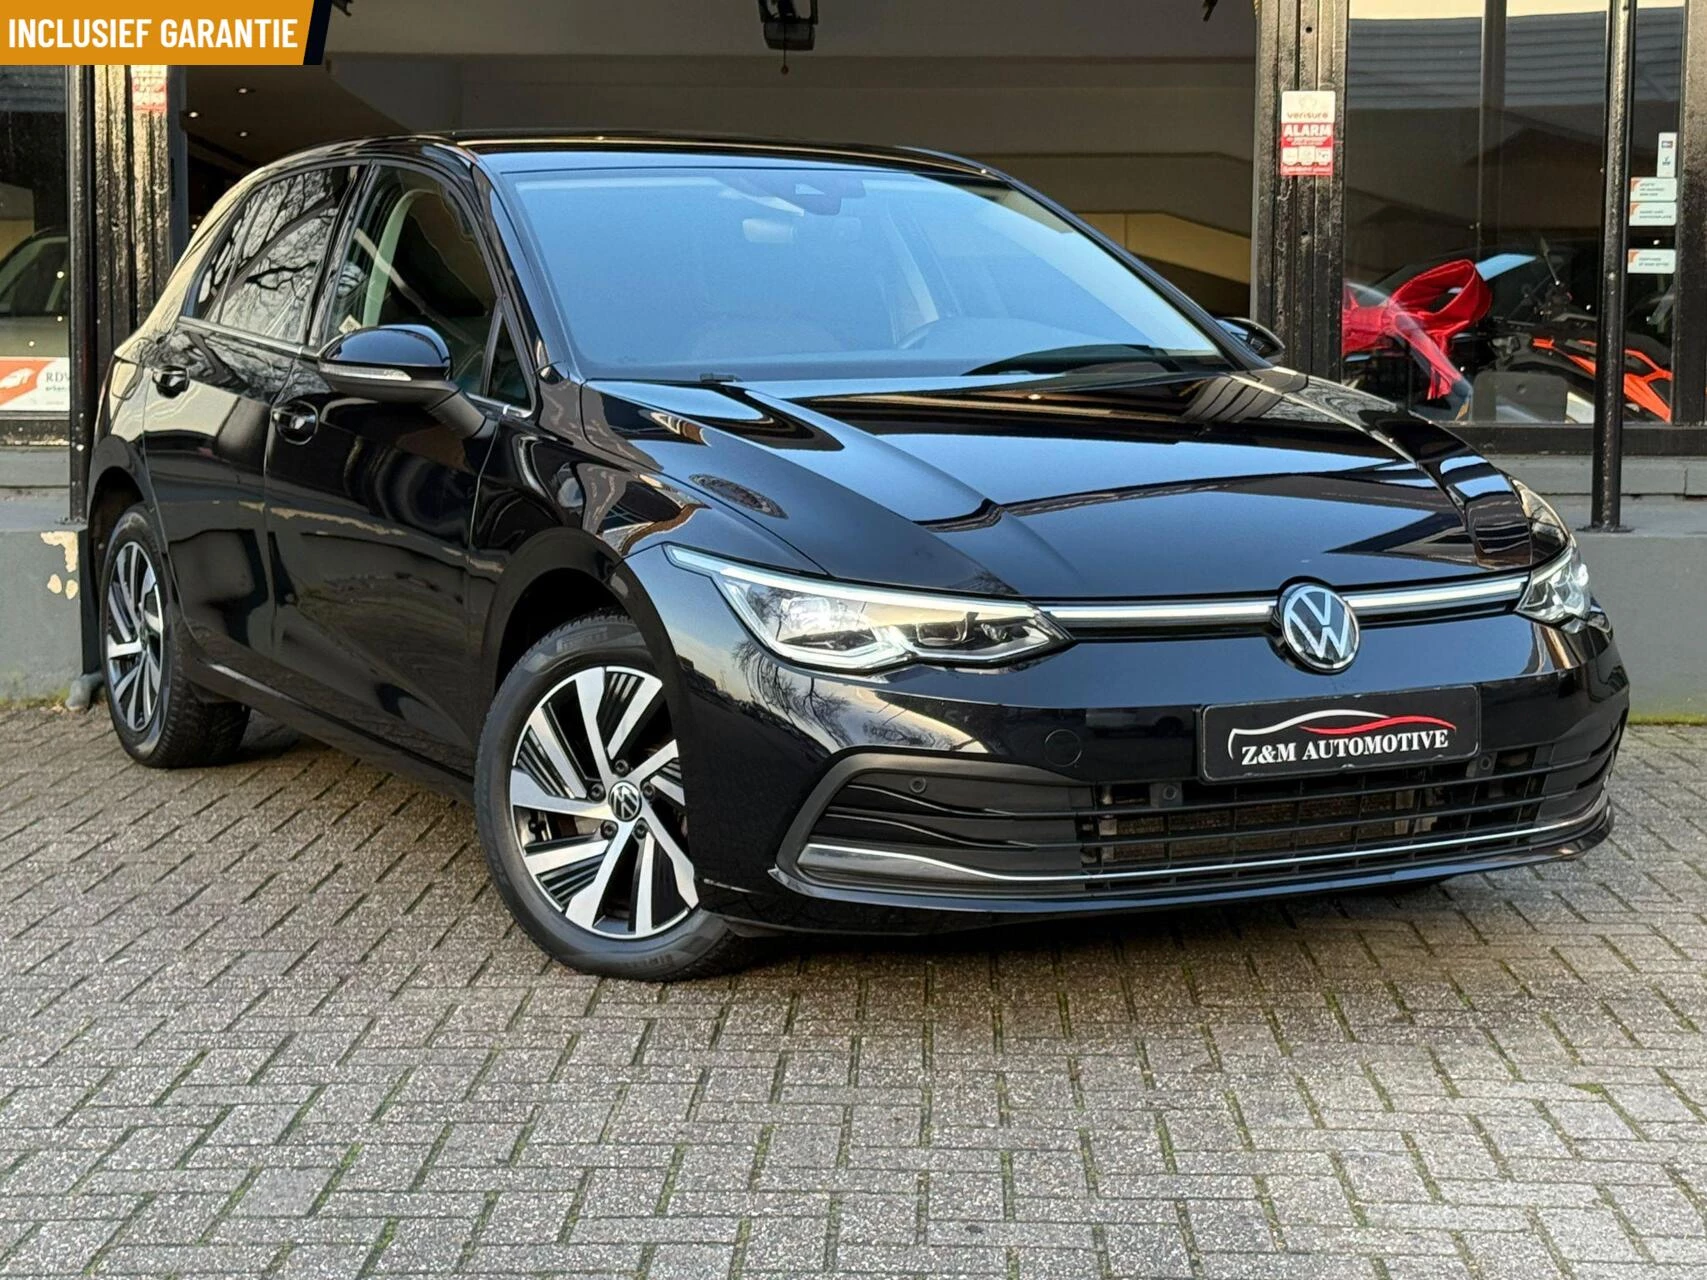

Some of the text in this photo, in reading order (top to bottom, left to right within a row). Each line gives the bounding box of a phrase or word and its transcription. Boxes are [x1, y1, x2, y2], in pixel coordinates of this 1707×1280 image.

[1283, 123, 1332, 137] ALARM
[1241, 729, 1449, 766] Z&M AUTOMOTIVE
